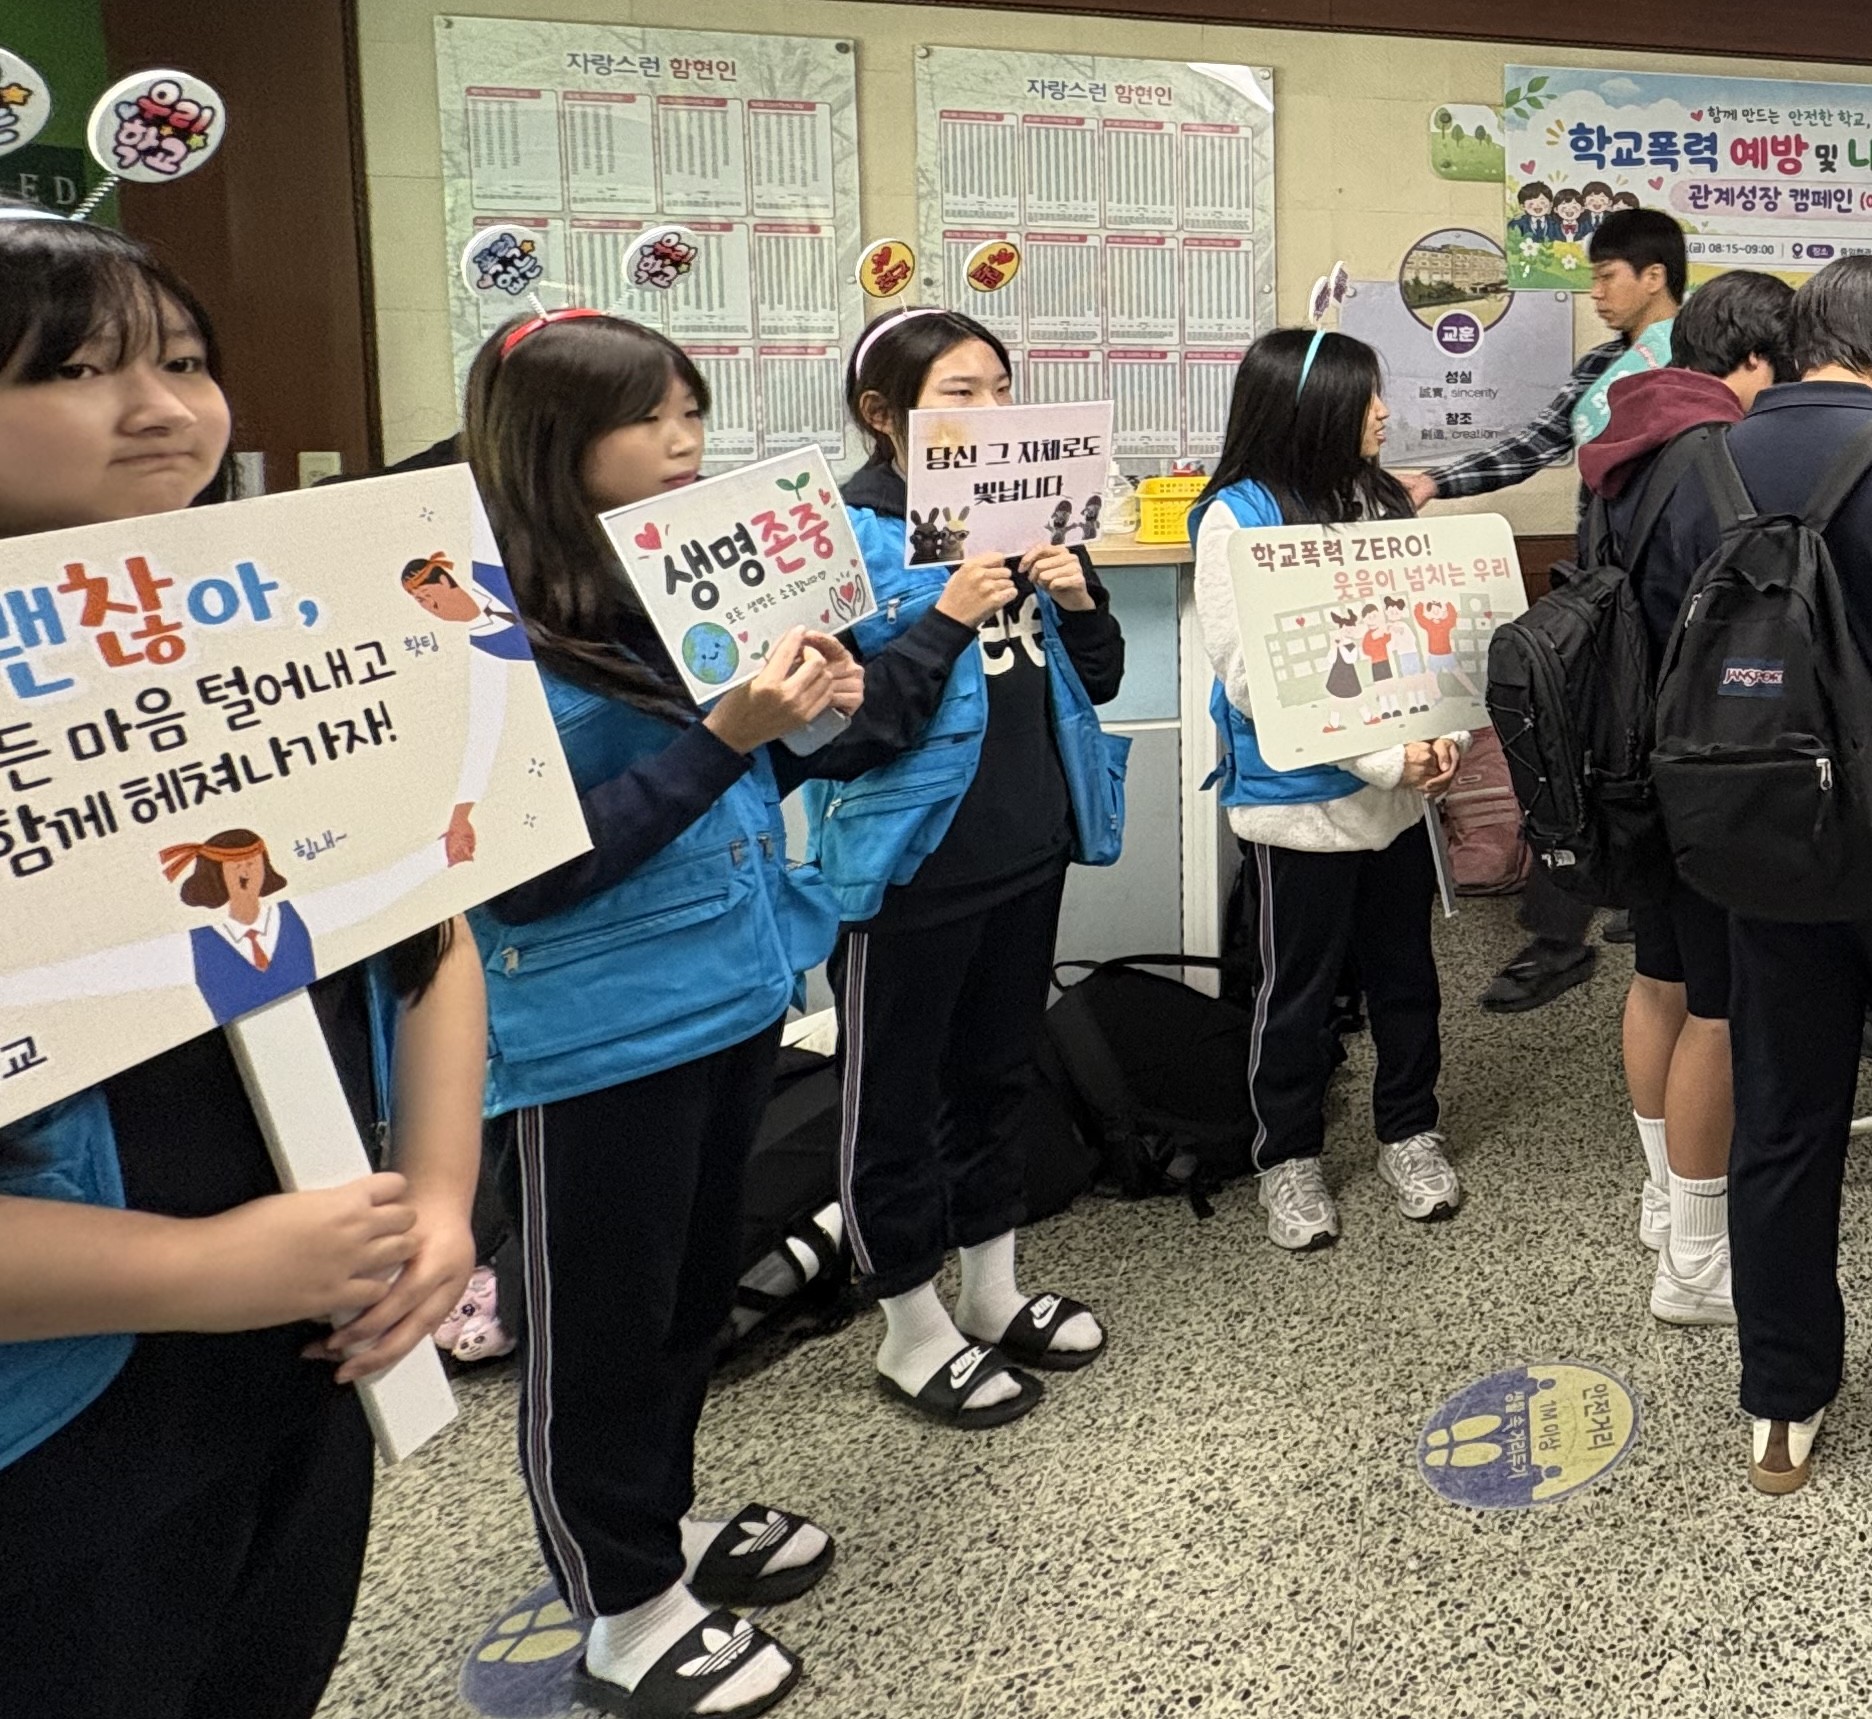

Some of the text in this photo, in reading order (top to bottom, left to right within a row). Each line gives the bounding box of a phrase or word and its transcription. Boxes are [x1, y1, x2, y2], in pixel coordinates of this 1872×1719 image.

[567, 52, 737, 82] 자랑스런 함현인
[138, 80, 214, 134] 우리
[1027, 79, 1172, 106] 자랑스런 함현인
[1708, 106, 1737, 123] 함께
[1742, 108, 1780, 125] 만드는
[1788, 109, 1832, 127] 안전한
[1838, 110, 1871, 129] 학교,
[113, 118, 188, 175] 학교
[1568, 122, 1718, 173] 학교폭력
[1730, 133, 1809, 175] 예방
[1815, 144, 1838, 173] 및
[1688, 184, 1782, 213] 관계성장
[1788, 188, 1852, 214] 캠페인
[1709, 242, 1774, 256] 08:15~09:00
[1442, 325, 1475, 343] 교훈
[1445, 370, 1472, 384] 성실
[926, 435, 1102, 470] 당신 그 자체로도
[974, 475, 1064, 506] 빛납니다
[1250, 534, 1432, 573] 학교폭력 ZERO!
[1333, 557, 1511, 601] 웃음이 넘치는 우리
[67, 686, 188, 761] 마음
[196, 641, 397, 731] 털어내고
[119, 700, 398, 824] 헤쳐나가자!
[950, 1345, 983, 1379] NIKE
[1582, 1383, 1616, 1451] 안전거리
[1539, 1423, 1562, 1451] 이상
[1506, 1430, 1530, 1480] 거리두기
